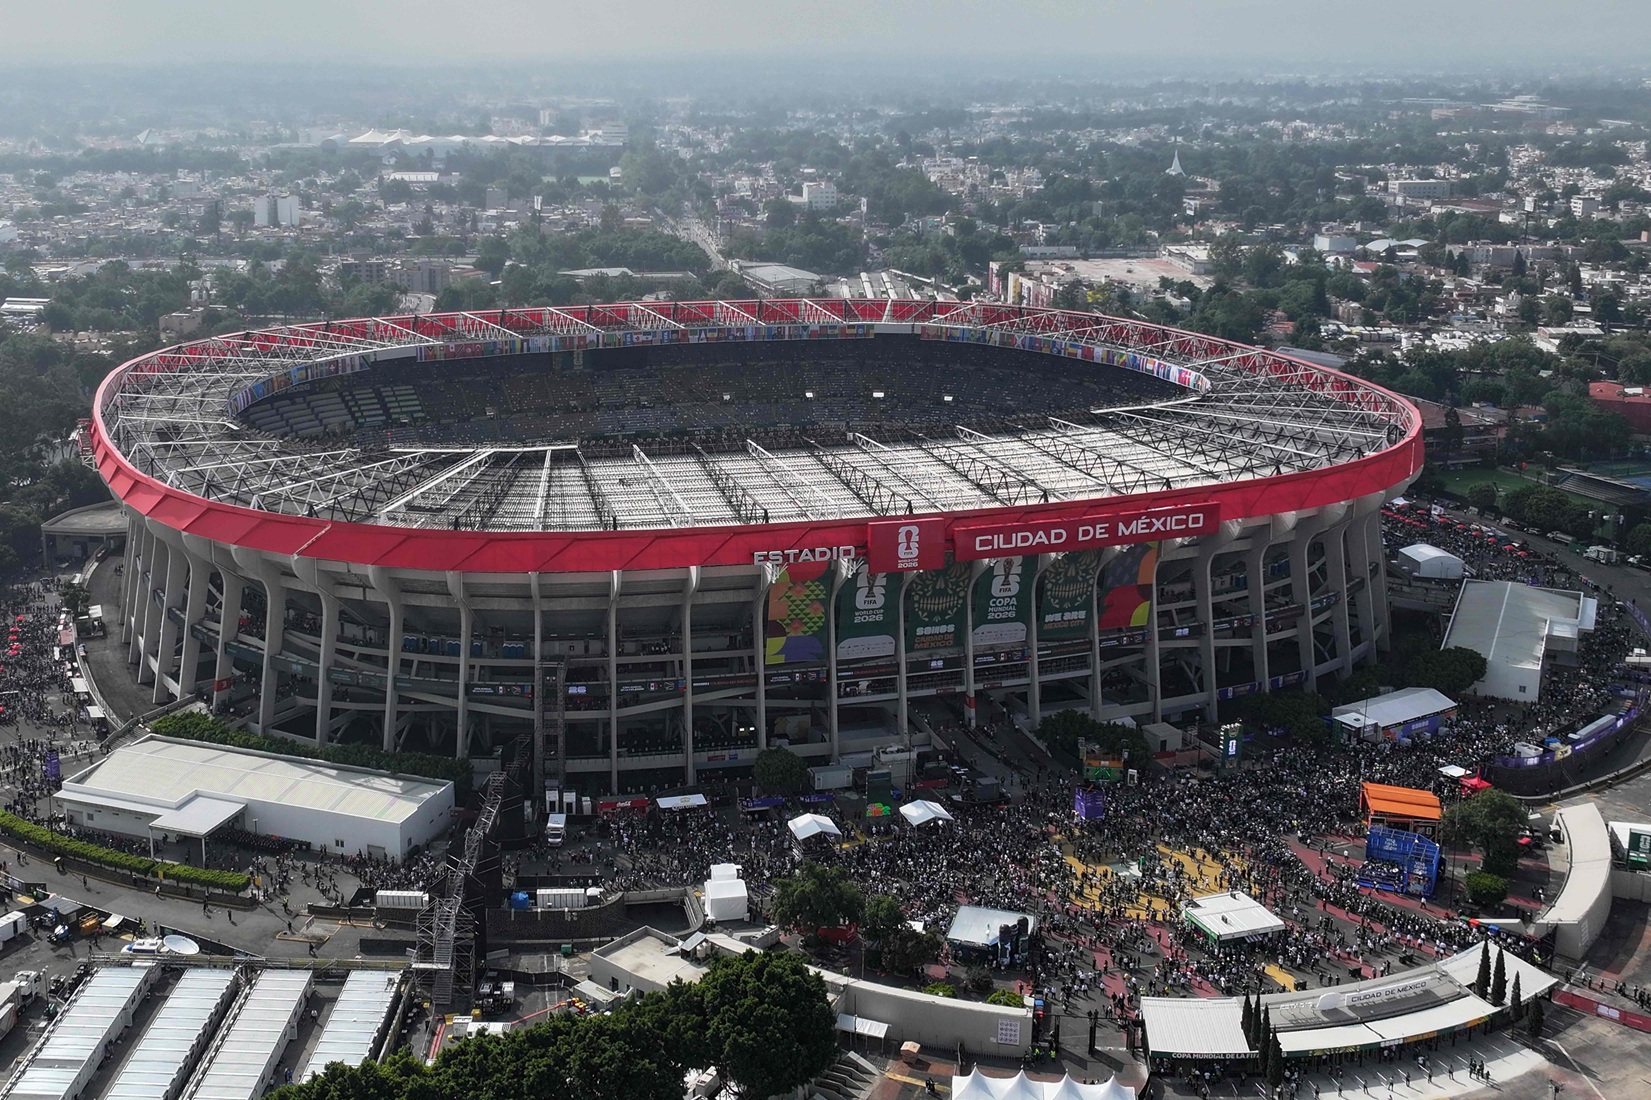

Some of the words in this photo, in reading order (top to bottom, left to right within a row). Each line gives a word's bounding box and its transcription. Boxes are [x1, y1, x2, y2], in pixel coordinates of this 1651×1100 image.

[975, 528, 1067, 551] CIUDAD
[1078, 523, 1110, 541] DE
[1118, 513, 1204, 536] MÉXICO
[754, 545, 856, 566] ESTADIO
[989, 597, 1018, 607] COPA
[988, 605, 1017, 613] MUNDIAL
[853, 614, 884, 623] 2026
[987, 611, 1016, 620] 2026
[915, 634, 944, 643] CIUDAD
[1351, 991, 1382, 1003] CIUDAD
[1384, 989, 1396, 997] DE
[1397, 981, 1427, 993] MÉXICO
